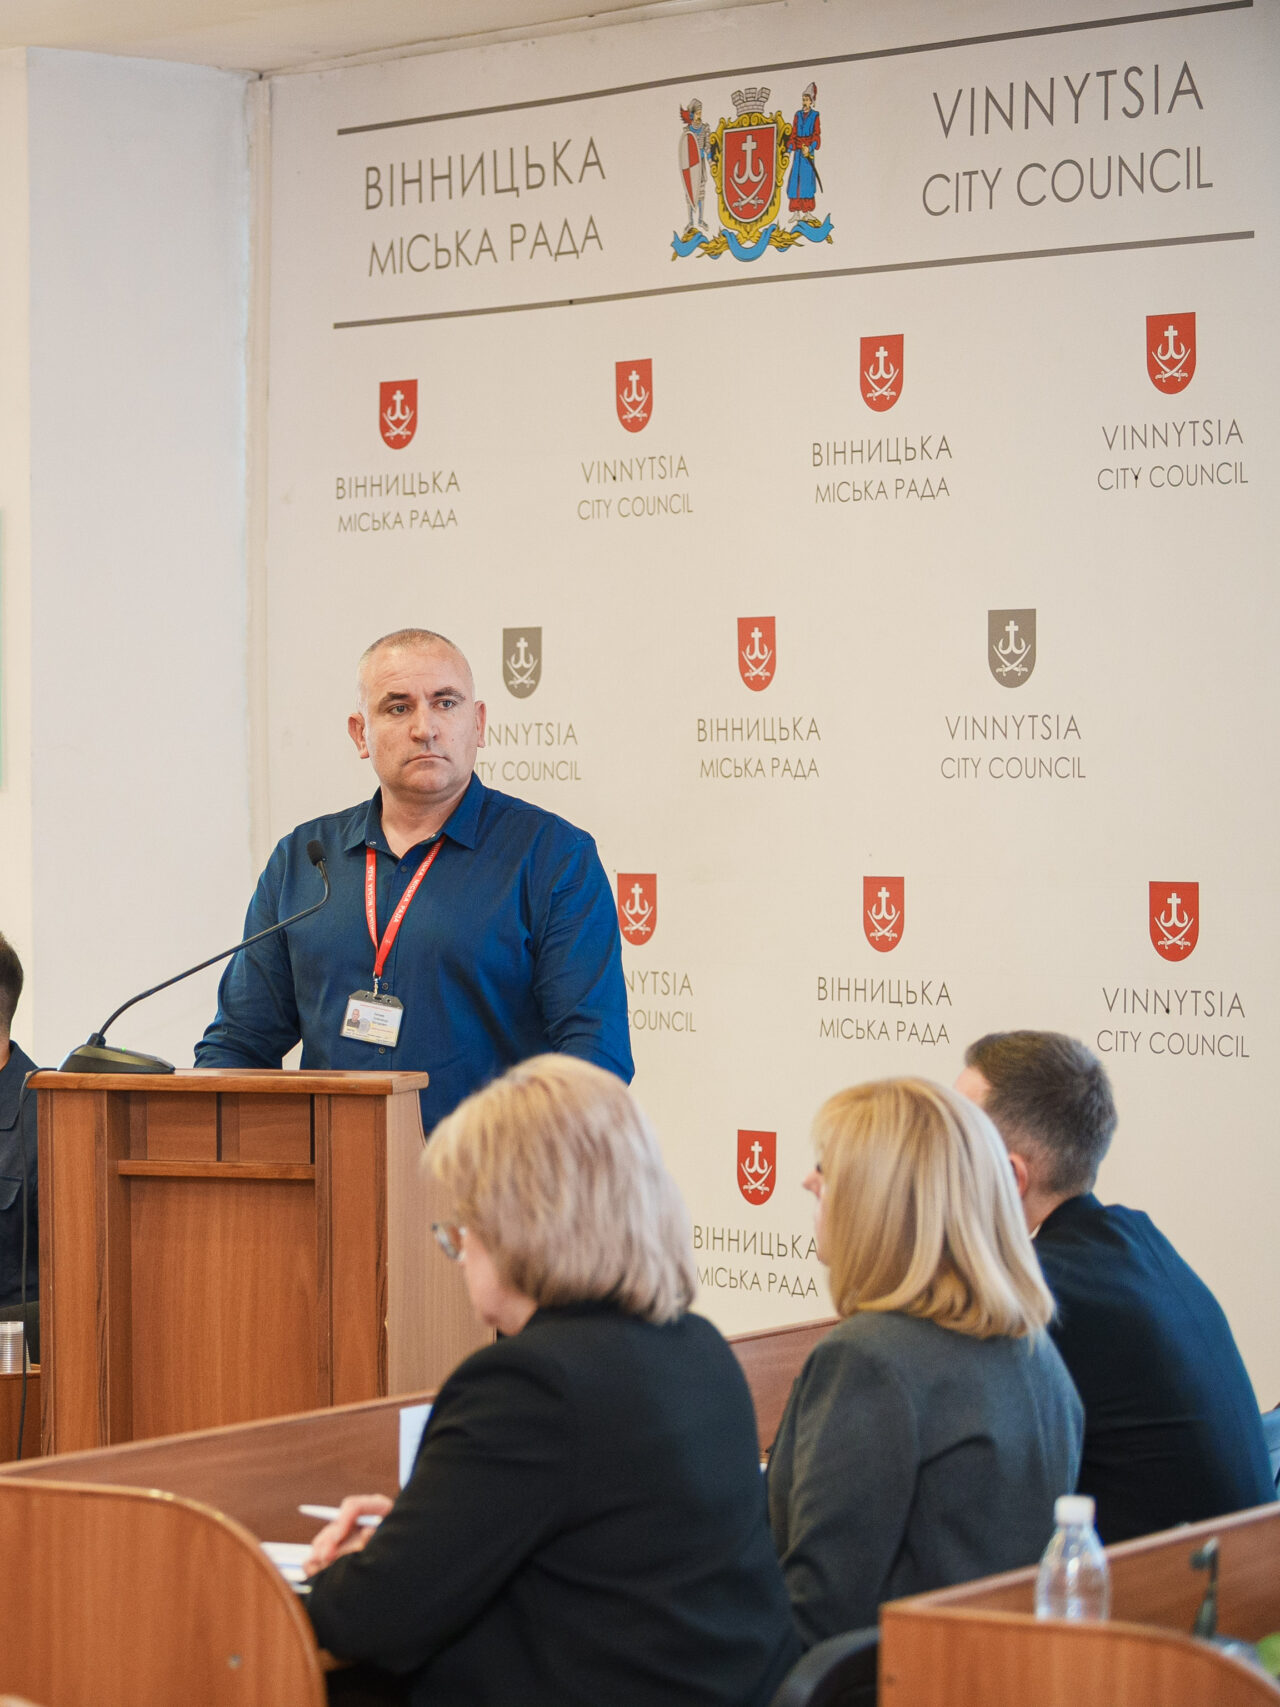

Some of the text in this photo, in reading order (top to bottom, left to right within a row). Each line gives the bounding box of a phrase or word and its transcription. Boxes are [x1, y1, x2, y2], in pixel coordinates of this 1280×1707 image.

[933, 60, 1203, 139] VINNYTSIA
[366, 136, 606, 210] ВІННИЦЬКА
[923, 146, 1213, 216] CITY COUNCIL
[369, 214, 603, 277] МІСЬКА РАДА
[1102, 419, 1243, 451] VINNYTSIA
[813, 435, 952, 467] ВІННИЦЬКА
[581, 456, 689, 483] VINNYTSIA
[1098, 462, 1248, 490] CITY COUNCIL
[336, 471, 460, 500] ВІННИЦЬКА
[816, 477, 950, 503] МІСЬКА РАДА
[339, 509, 457, 532] МІСЬКА РАДА
[578, 494, 693, 520] CITY COUNCIL
[489, 722, 577, 746] NNYTSIA
[698, 717, 821, 744] ВІННИЦЬКА
[945, 714, 1081, 740] VINNYTSIA
[503, 761, 581, 781] COUNCIL
[700, 757, 819, 780] МІСЬКА РАДА
[941, 757, 1086, 779] CITY COUNCIL
[625, 970, 693, 996] NYTSIA
[818, 976, 952, 1008] ВІННИЦЬКА
[1102, 987, 1245, 1018] VINNYTSIA
[629, 1009, 696, 1032] OUNCIL
[820, 1018, 950, 1046] МІСЬКА РАДА
[1097, 1030, 1250, 1058] CITY COUNCIL
[694, 1225, 816, 1260] ВІННИЦЬКА
[697, 1267, 818, 1299] МІСЬКА РАДА
